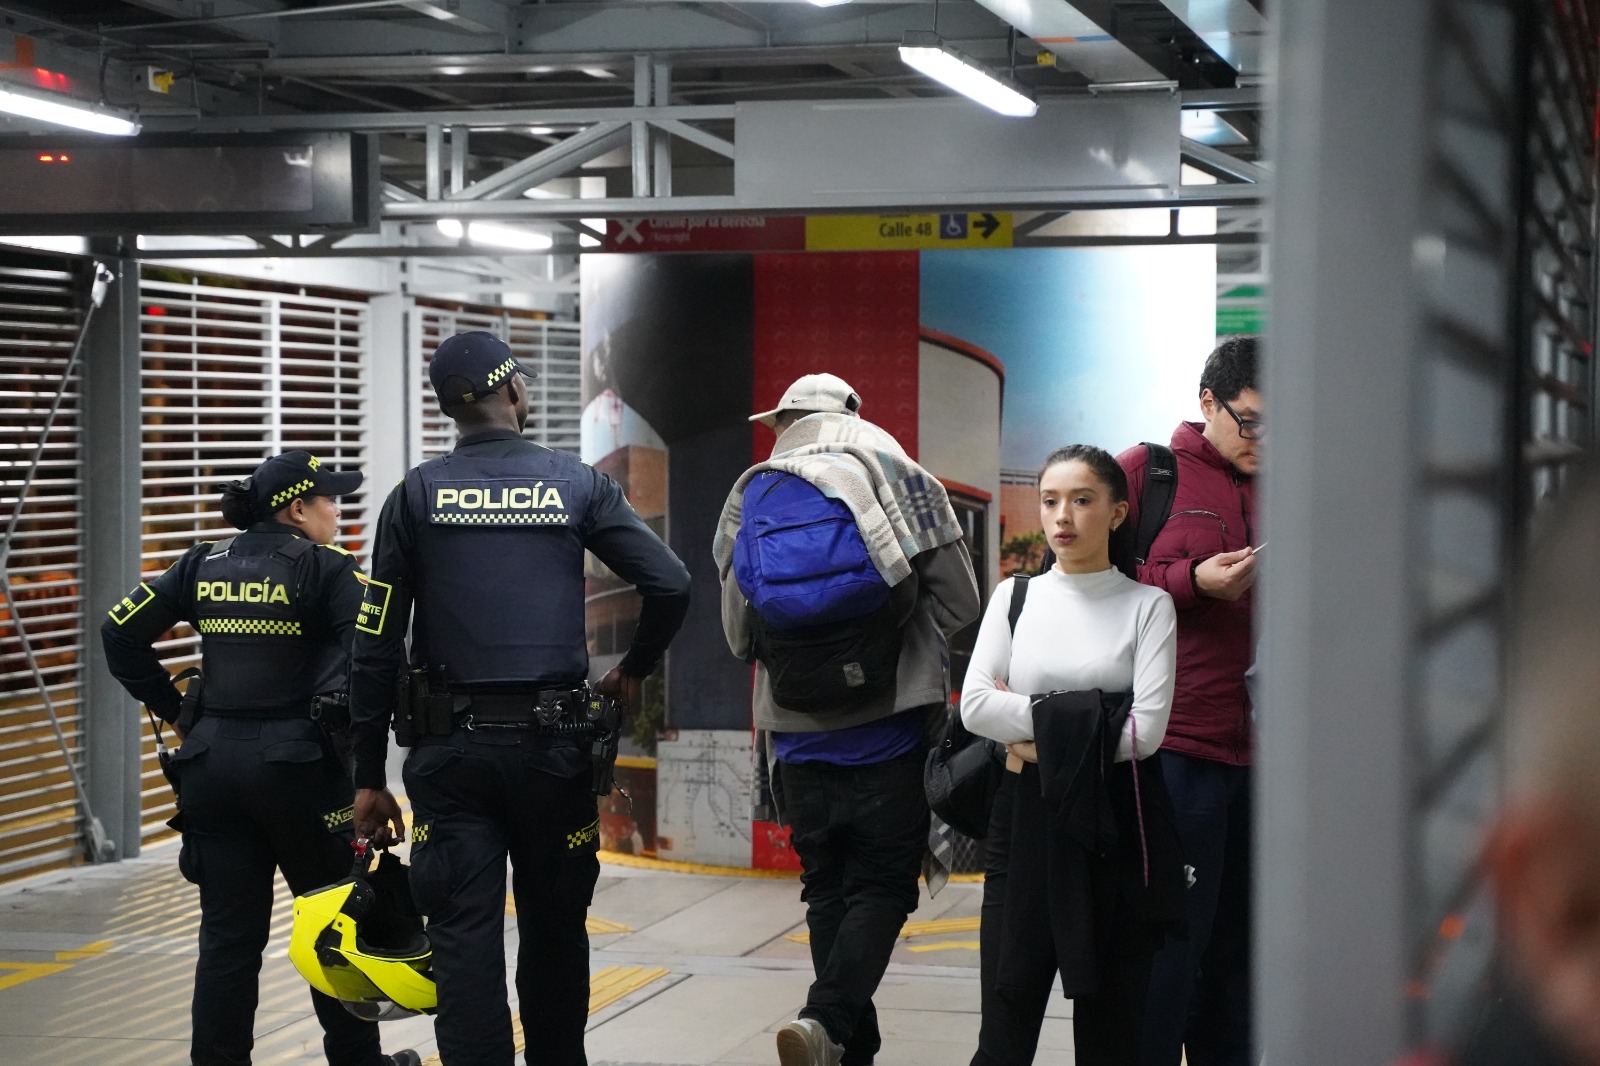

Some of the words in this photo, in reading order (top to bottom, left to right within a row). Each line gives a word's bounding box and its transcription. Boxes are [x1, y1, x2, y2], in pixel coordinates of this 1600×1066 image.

[879, 221, 913, 237] Calle
[915, 221, 932, 237] 48
[436, 481, 565, 509] POLICÍA
[197, 576, 290, 605] POLICÍA
[342, 809, 355, 820] PO
